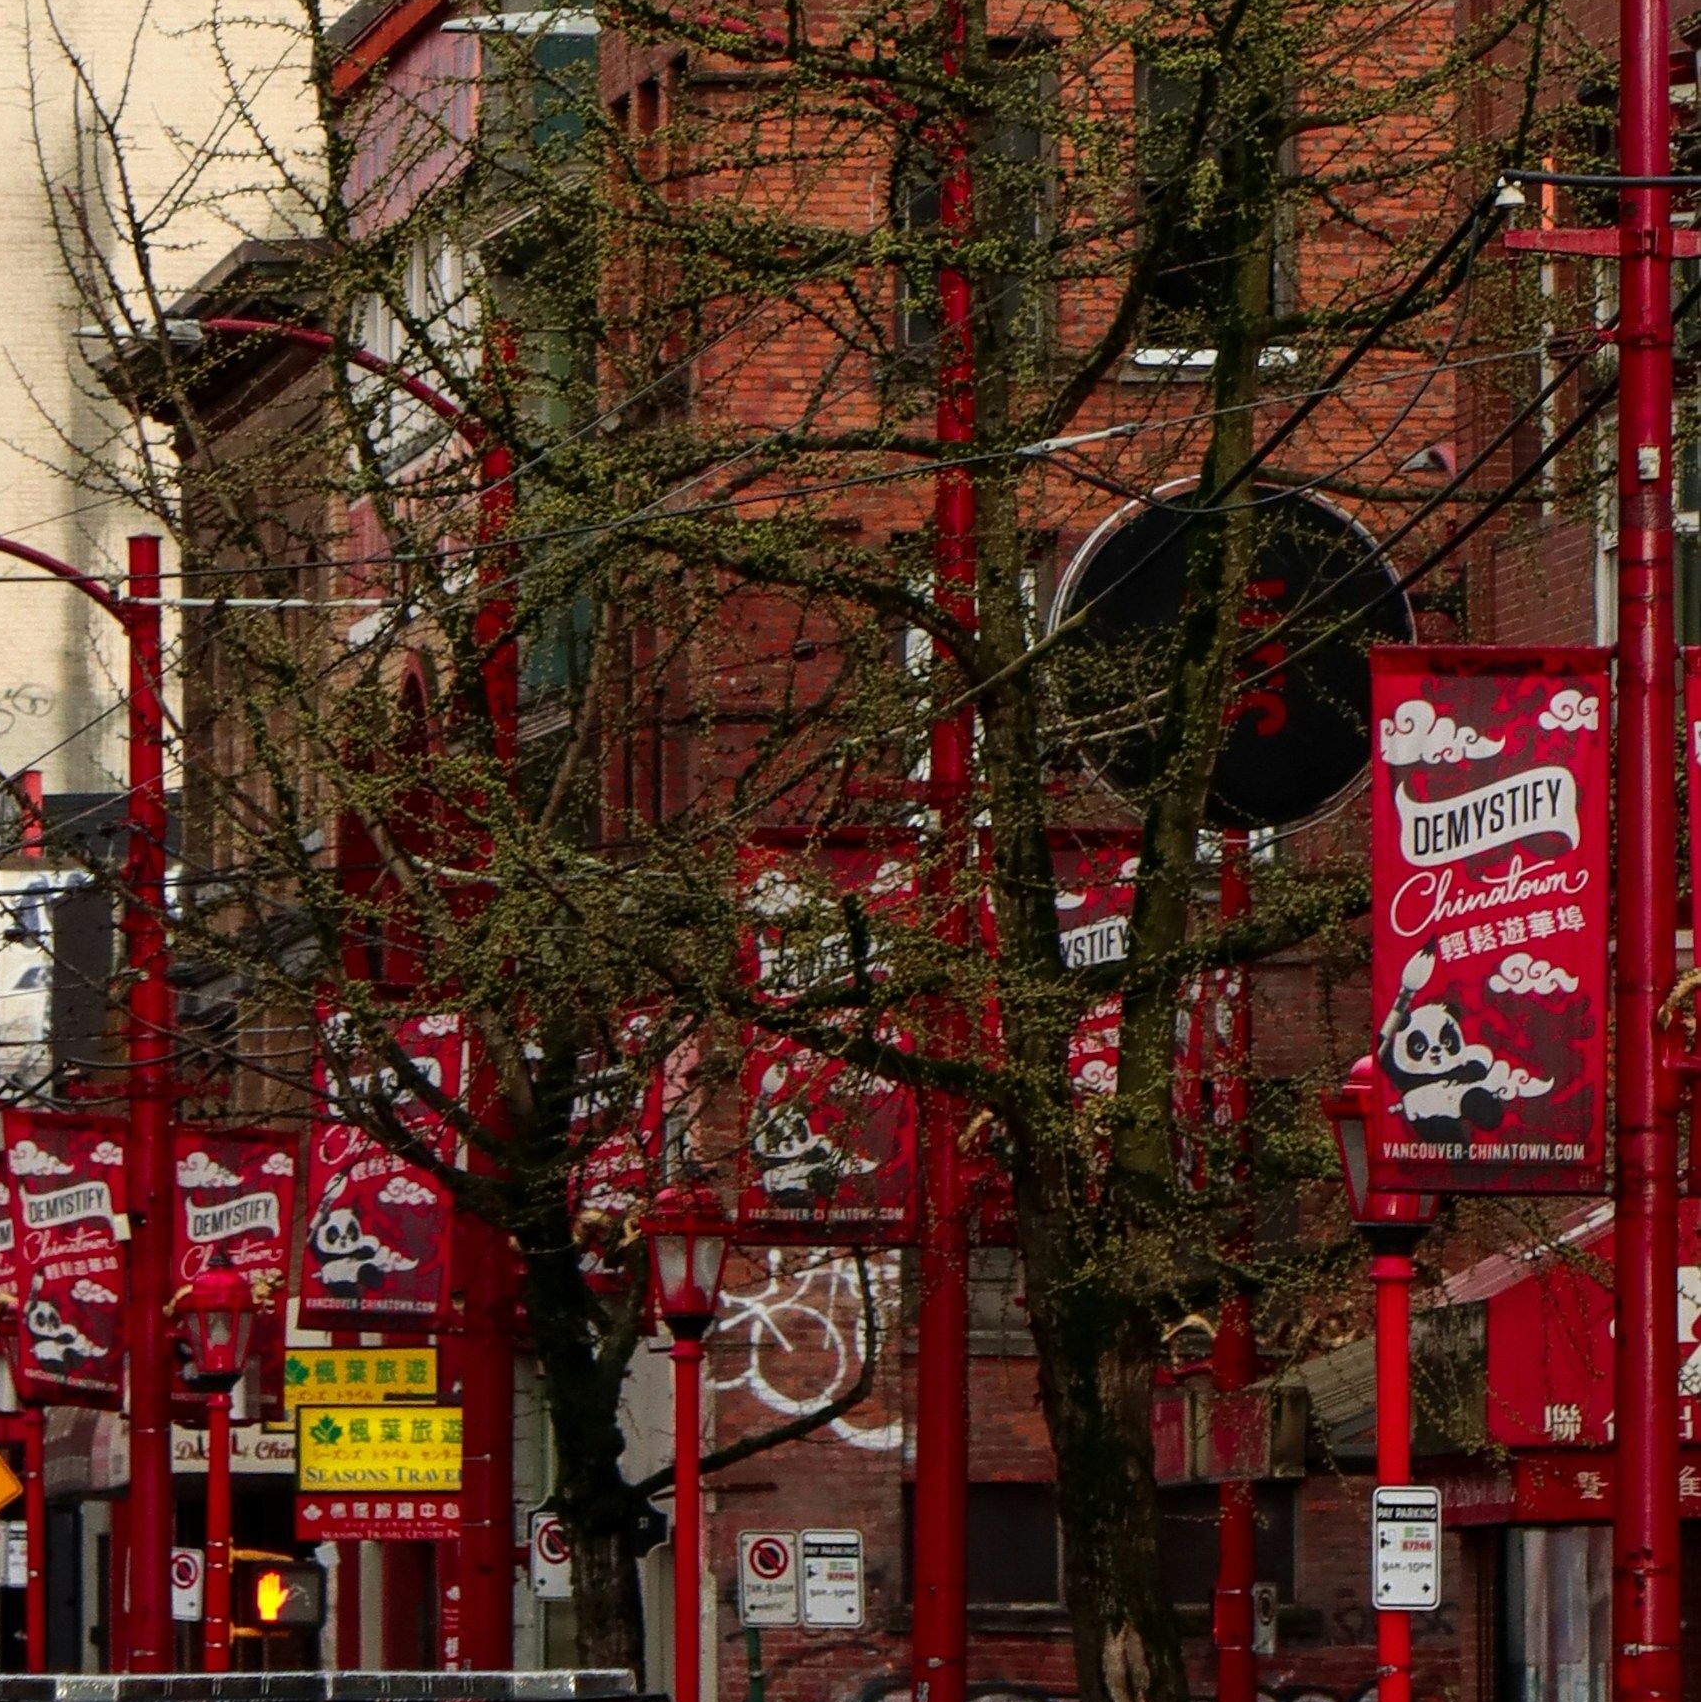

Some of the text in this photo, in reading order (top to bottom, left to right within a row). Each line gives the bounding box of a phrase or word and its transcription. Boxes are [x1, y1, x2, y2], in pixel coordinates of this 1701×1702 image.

[1413, 778, 1563, 858] DEMYSTIFY
[1390, 854, 1590, 938] Chinatown
[1438, 904, 1587, 963] 輕鬆遊華埠
[1382, 1141, 1586, 1162] VANCOUVER-CHINATOWN.COM
[28, 1188, 105, 1224] DEMYSTIFY
[193, 1199, 272, 1238] DEMYSTIFY
